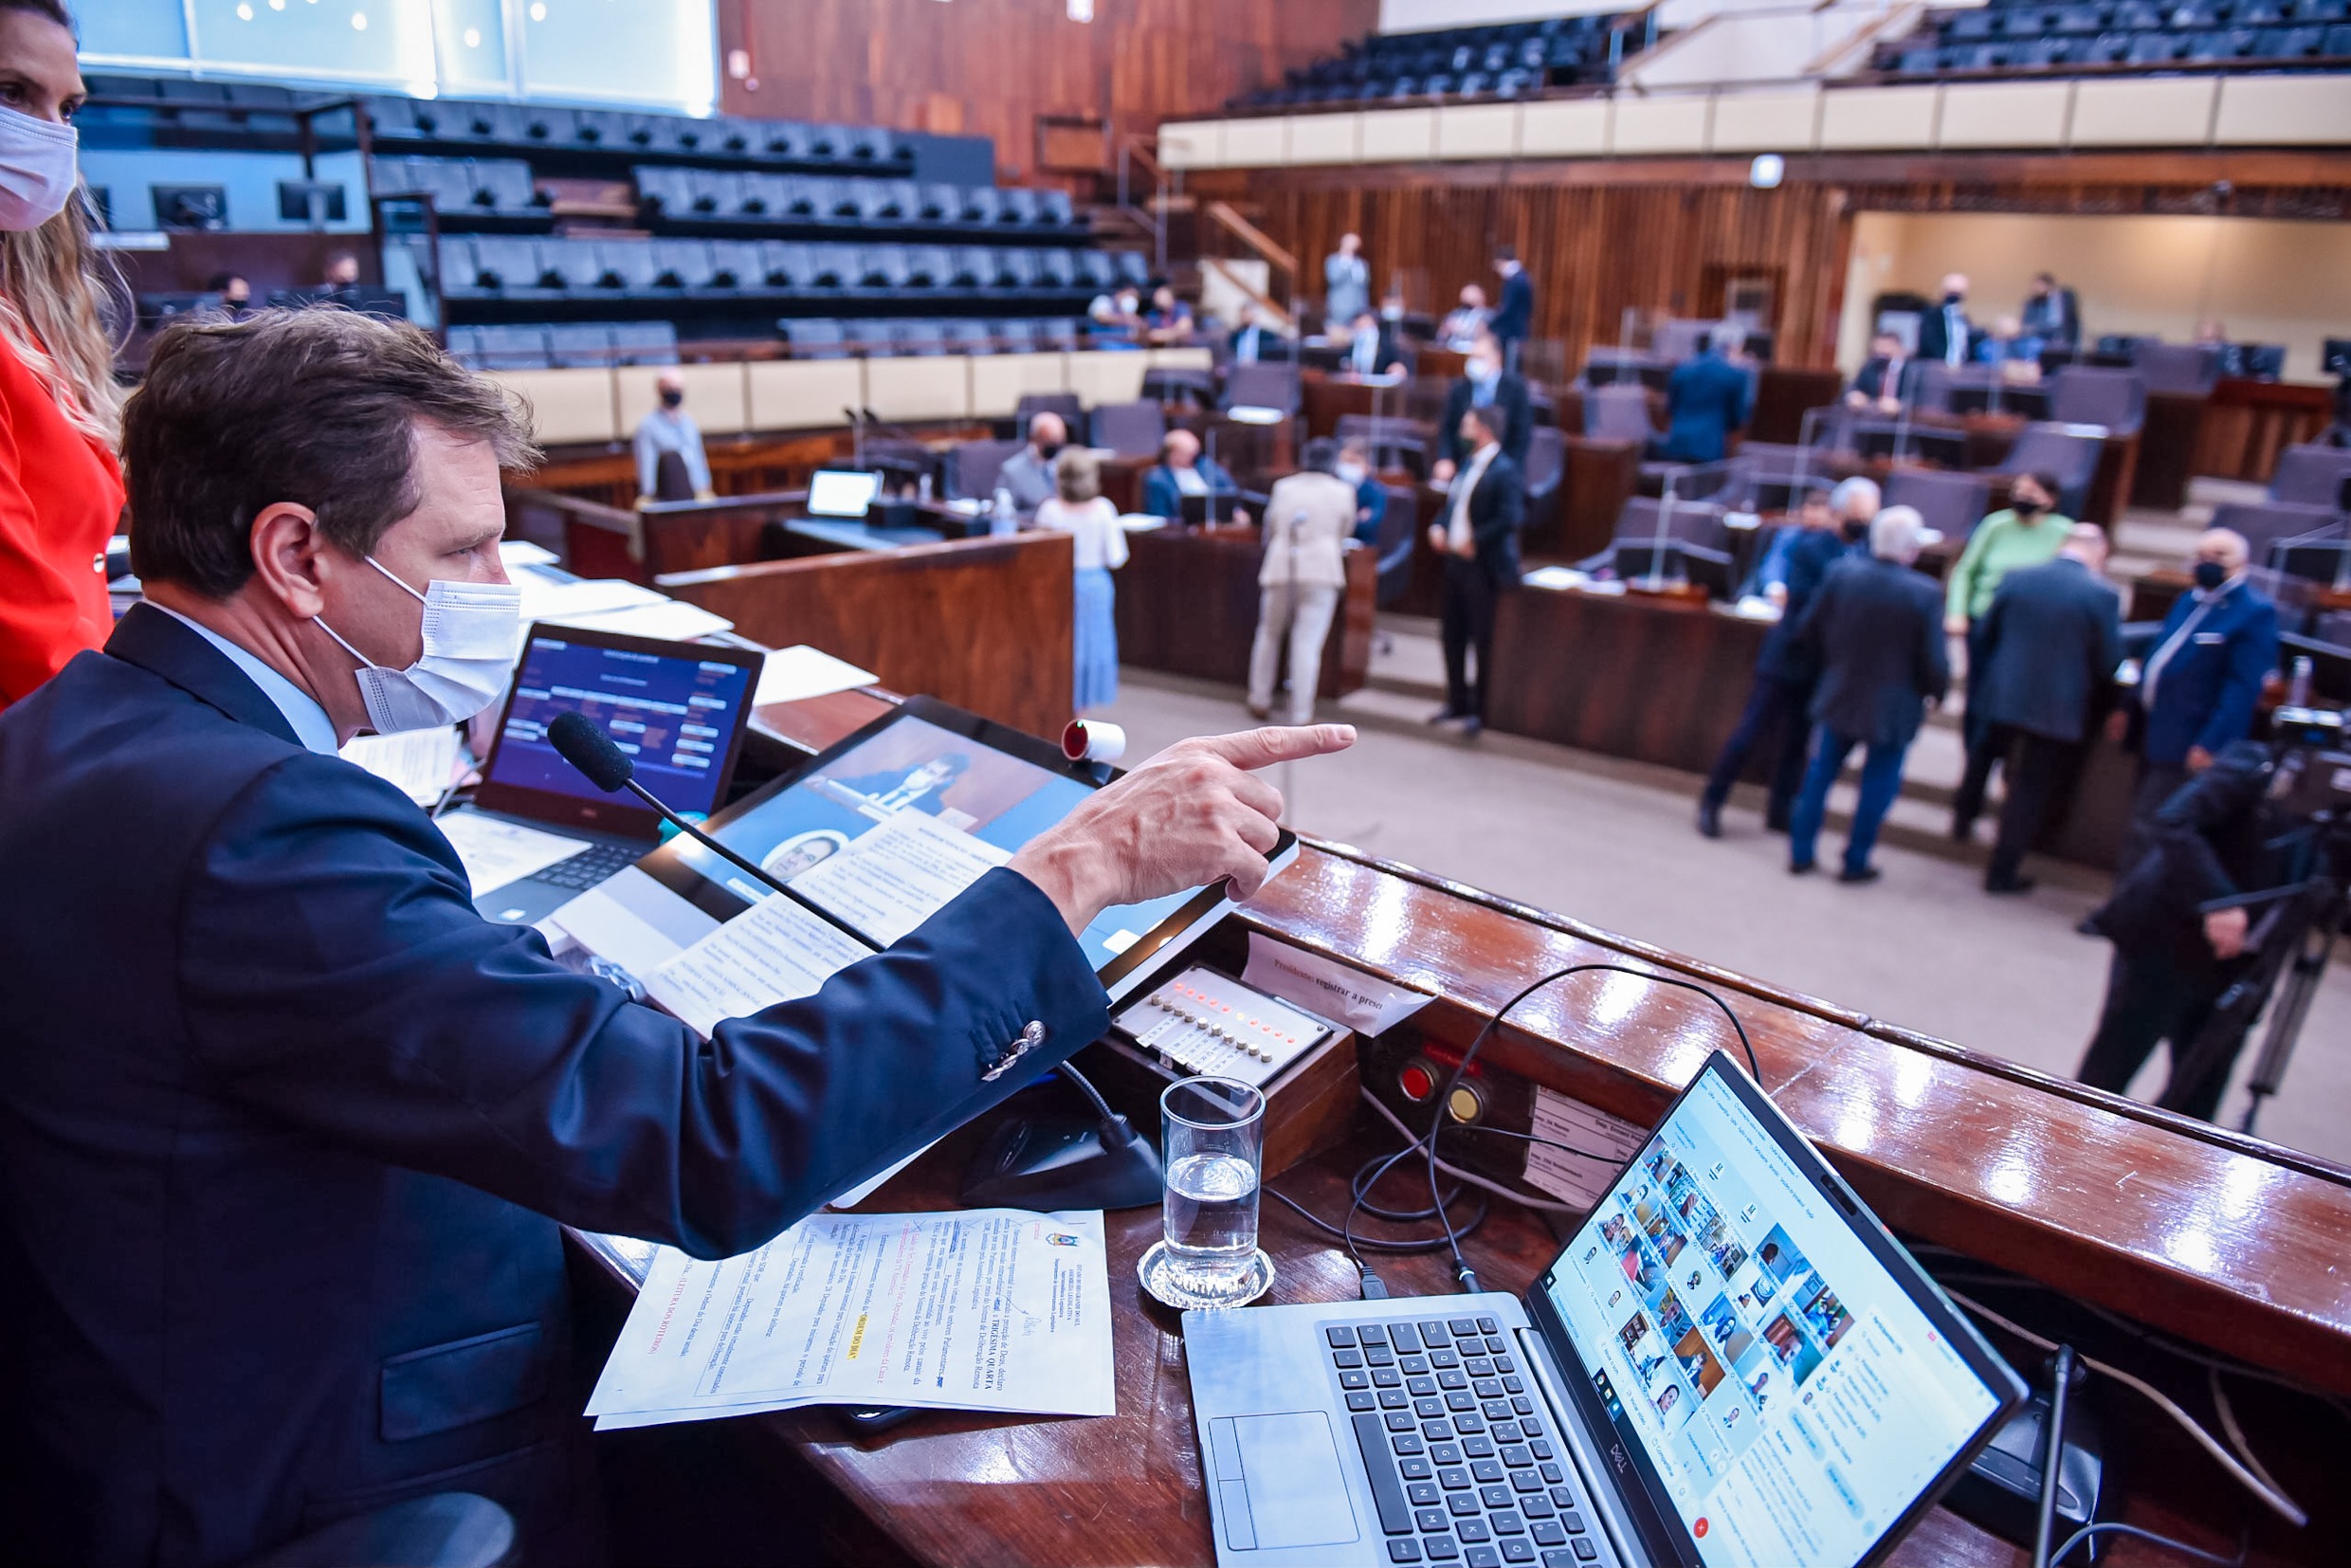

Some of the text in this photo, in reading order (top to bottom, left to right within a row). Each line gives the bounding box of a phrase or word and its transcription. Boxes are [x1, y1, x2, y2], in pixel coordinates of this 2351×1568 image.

[1316, 978, 1351, 997] registrar
[669, 1278, 687, 1305] (LEITURA
[916, 1298, 926, 1314] Sistema
[980, 1305, 991, 1323] Sistema
[687, 1328, 699, 1340] desta
[829, 1322, 842, 1346] verificação
[908, 1322, 921, 1348] Deliberação
[945, 1315, 955, 1336] senhores
[1001, 1320, 1010, 1341] proteção
[647, 1321, 671, 1354] ROTEIROS)
[884, 1334, 895, 1358] servidores
[975, 1333, 987, 1364] Deliberação
[721, 1336, 739, 1364] virtualmente
[920, 1342, 928, 1356] pelos
[985, 1320, 1000, 1390] TRIGÉSIMA QUARTA
[998, 1351, 1008, 1367] Deus,
[799, 1359, 810, 1377] período
[821, 1354, 832, 1372] quórum
[879, 1366, 888, 1378] Casa
[903, 1350, 914, 1372] Remota.
[915, 1358, 924, 1376] canais
[710, 1366, 730, 1394] conectados
[973, 1366, 983, 1389] Remota
[996, 1368, 1005, 1391] declaro
[1611, 1443, 1627, 1473] DELL
